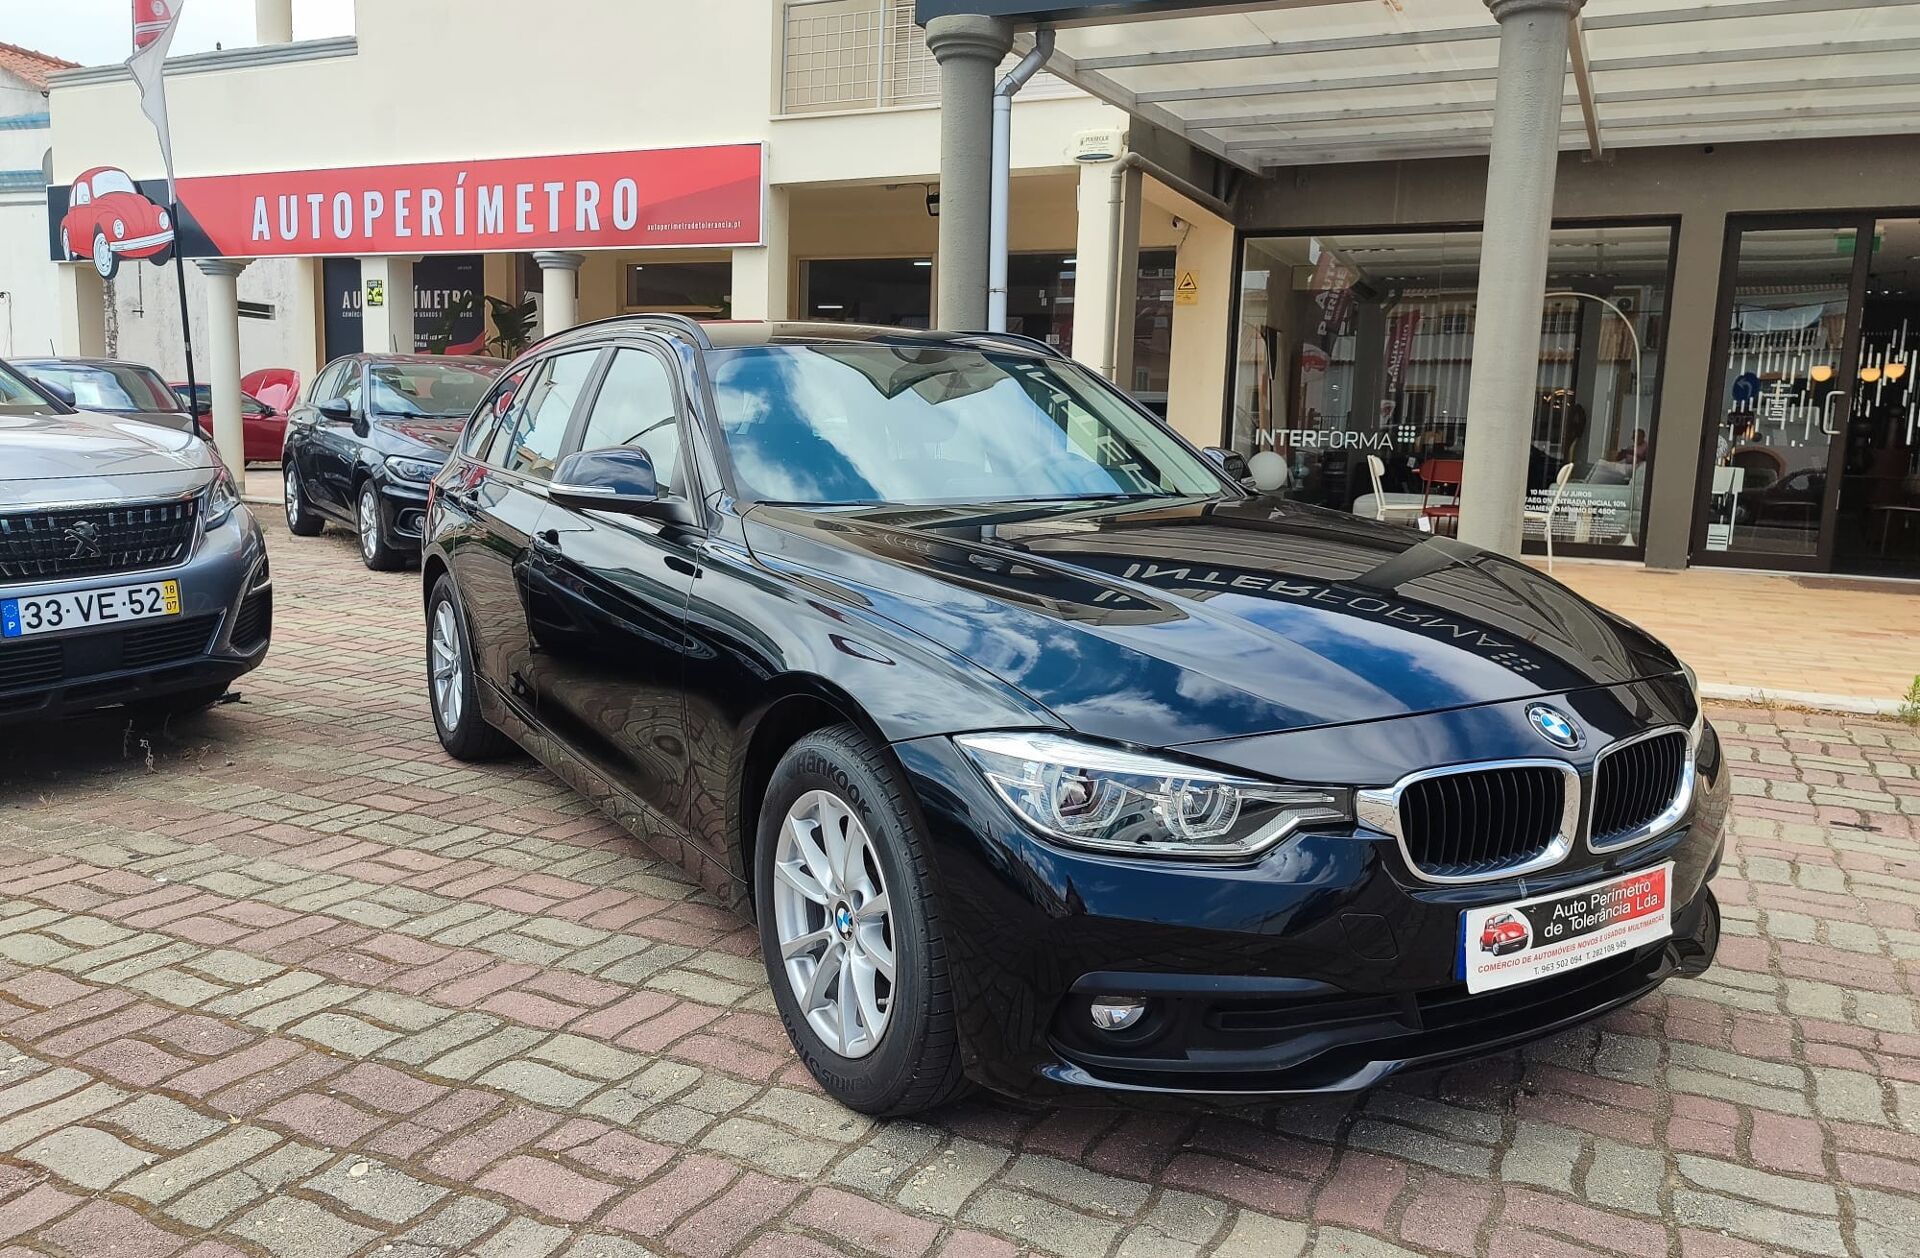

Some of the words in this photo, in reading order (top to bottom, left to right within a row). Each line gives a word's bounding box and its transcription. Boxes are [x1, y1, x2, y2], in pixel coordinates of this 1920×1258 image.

[251, 171, 639, 242] AUTOPERÍMETRO
[1255, 428, 1394, 450] INTERFORMA
[164, 585, 176, 595] 18
[165, 600, 177, 611] 07
[8, 621, 16, 631] P
[1544, 922, 1563, 938] de
[1568, 901, 1631, 931] Tolerância
[1636, 893, 1661, 911] Lda.
[1553, 900, 1587, 920] Auto
[1522, 955, 1533, 964] DE
[1533, 943, 1576, 961] AUTOMÓVEIS
[1577, 936, 1599, 949] NOVOS
[1603, 928, 1627, 941] USADOS
[1627, 914, 1665, 933] MULTIMARCAS
[1541, 963, 1554, 973] 963
[1556, 959, 1569, 968] 502
